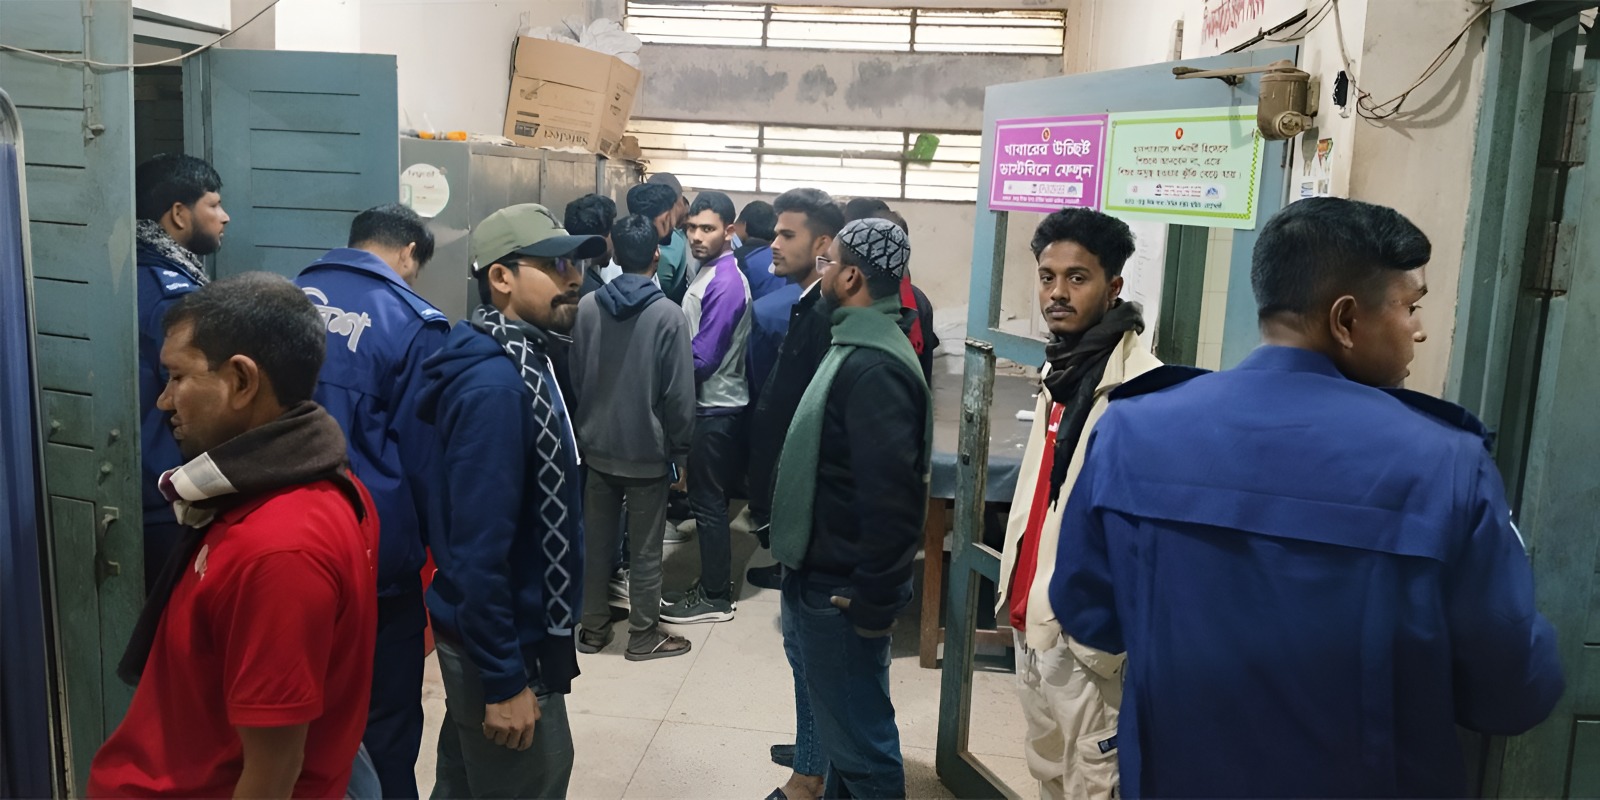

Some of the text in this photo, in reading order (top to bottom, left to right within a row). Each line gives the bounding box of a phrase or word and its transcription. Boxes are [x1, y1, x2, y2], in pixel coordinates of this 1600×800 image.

[1004, 138, 1091, 157] খাবারের উচ্ছিষ্ট
[1000, 159, 1094, 181] ডাস্টবিনে ফেলুন
